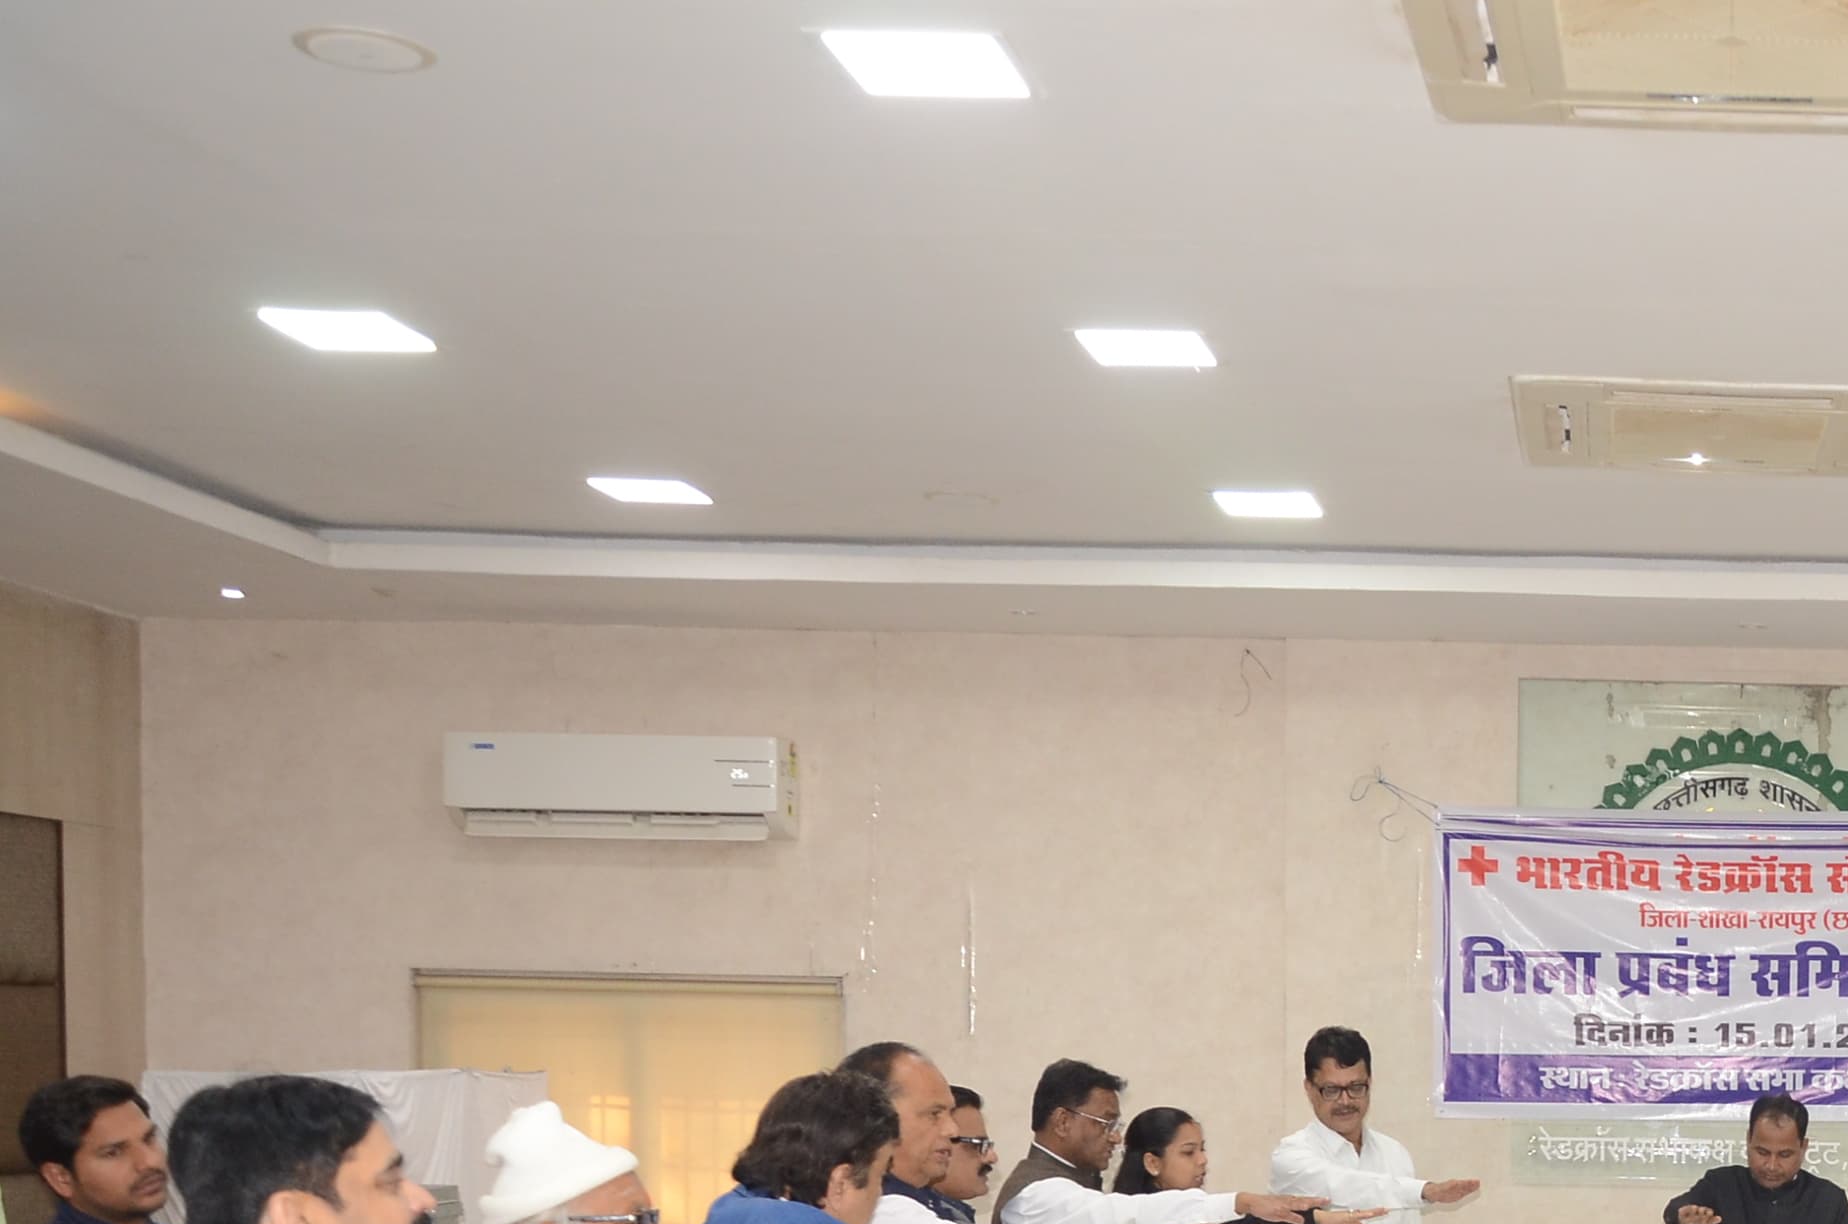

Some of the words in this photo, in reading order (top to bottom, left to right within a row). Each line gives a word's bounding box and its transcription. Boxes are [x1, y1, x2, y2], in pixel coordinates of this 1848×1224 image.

[1516, 850, 1662, 891] भारतीय
[1674, 854, 1813, 893] रेडक्रॉस
[1460, 936, 1602, 995] जिला
[1616, 937, 1736, 998] प्रबंध
[1574, 1012, 1675, 1047] दिनांक
[1539, 1066, 1614, 1090] स्थान
[1632, 1059, 1739, 1092] रेडक्रॉस
[1745, 1067, 1807, 1092] सभा
[1538, 1125, 1630, 1163] रेडक्रॉस
